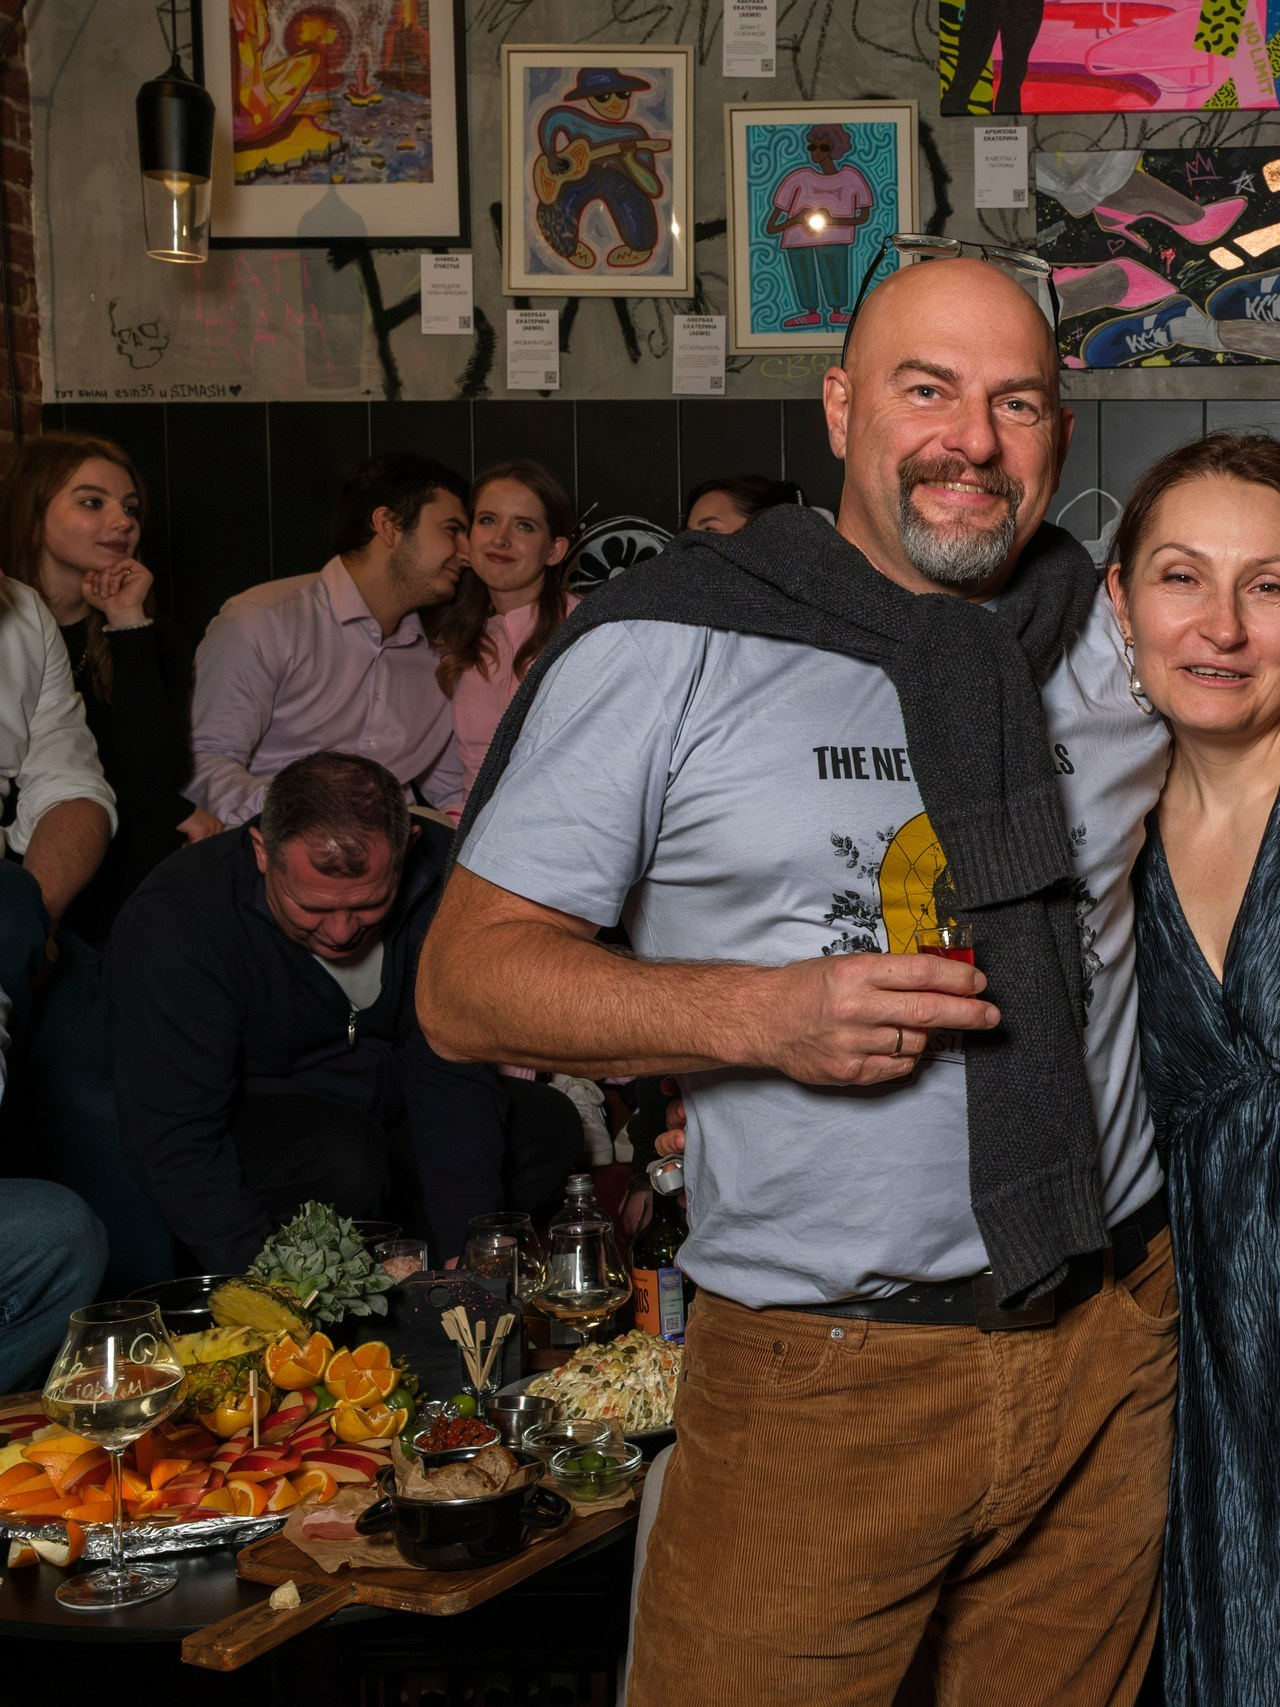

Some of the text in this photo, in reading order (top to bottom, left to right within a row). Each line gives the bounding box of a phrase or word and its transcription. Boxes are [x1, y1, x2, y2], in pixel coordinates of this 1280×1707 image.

[1243, 21, 1274, 96] NO LIMIT
[170, 382, 227, 399] SIMASH
[813, 746, 870, 780] THE
[871, 747, 917, 782] NE
